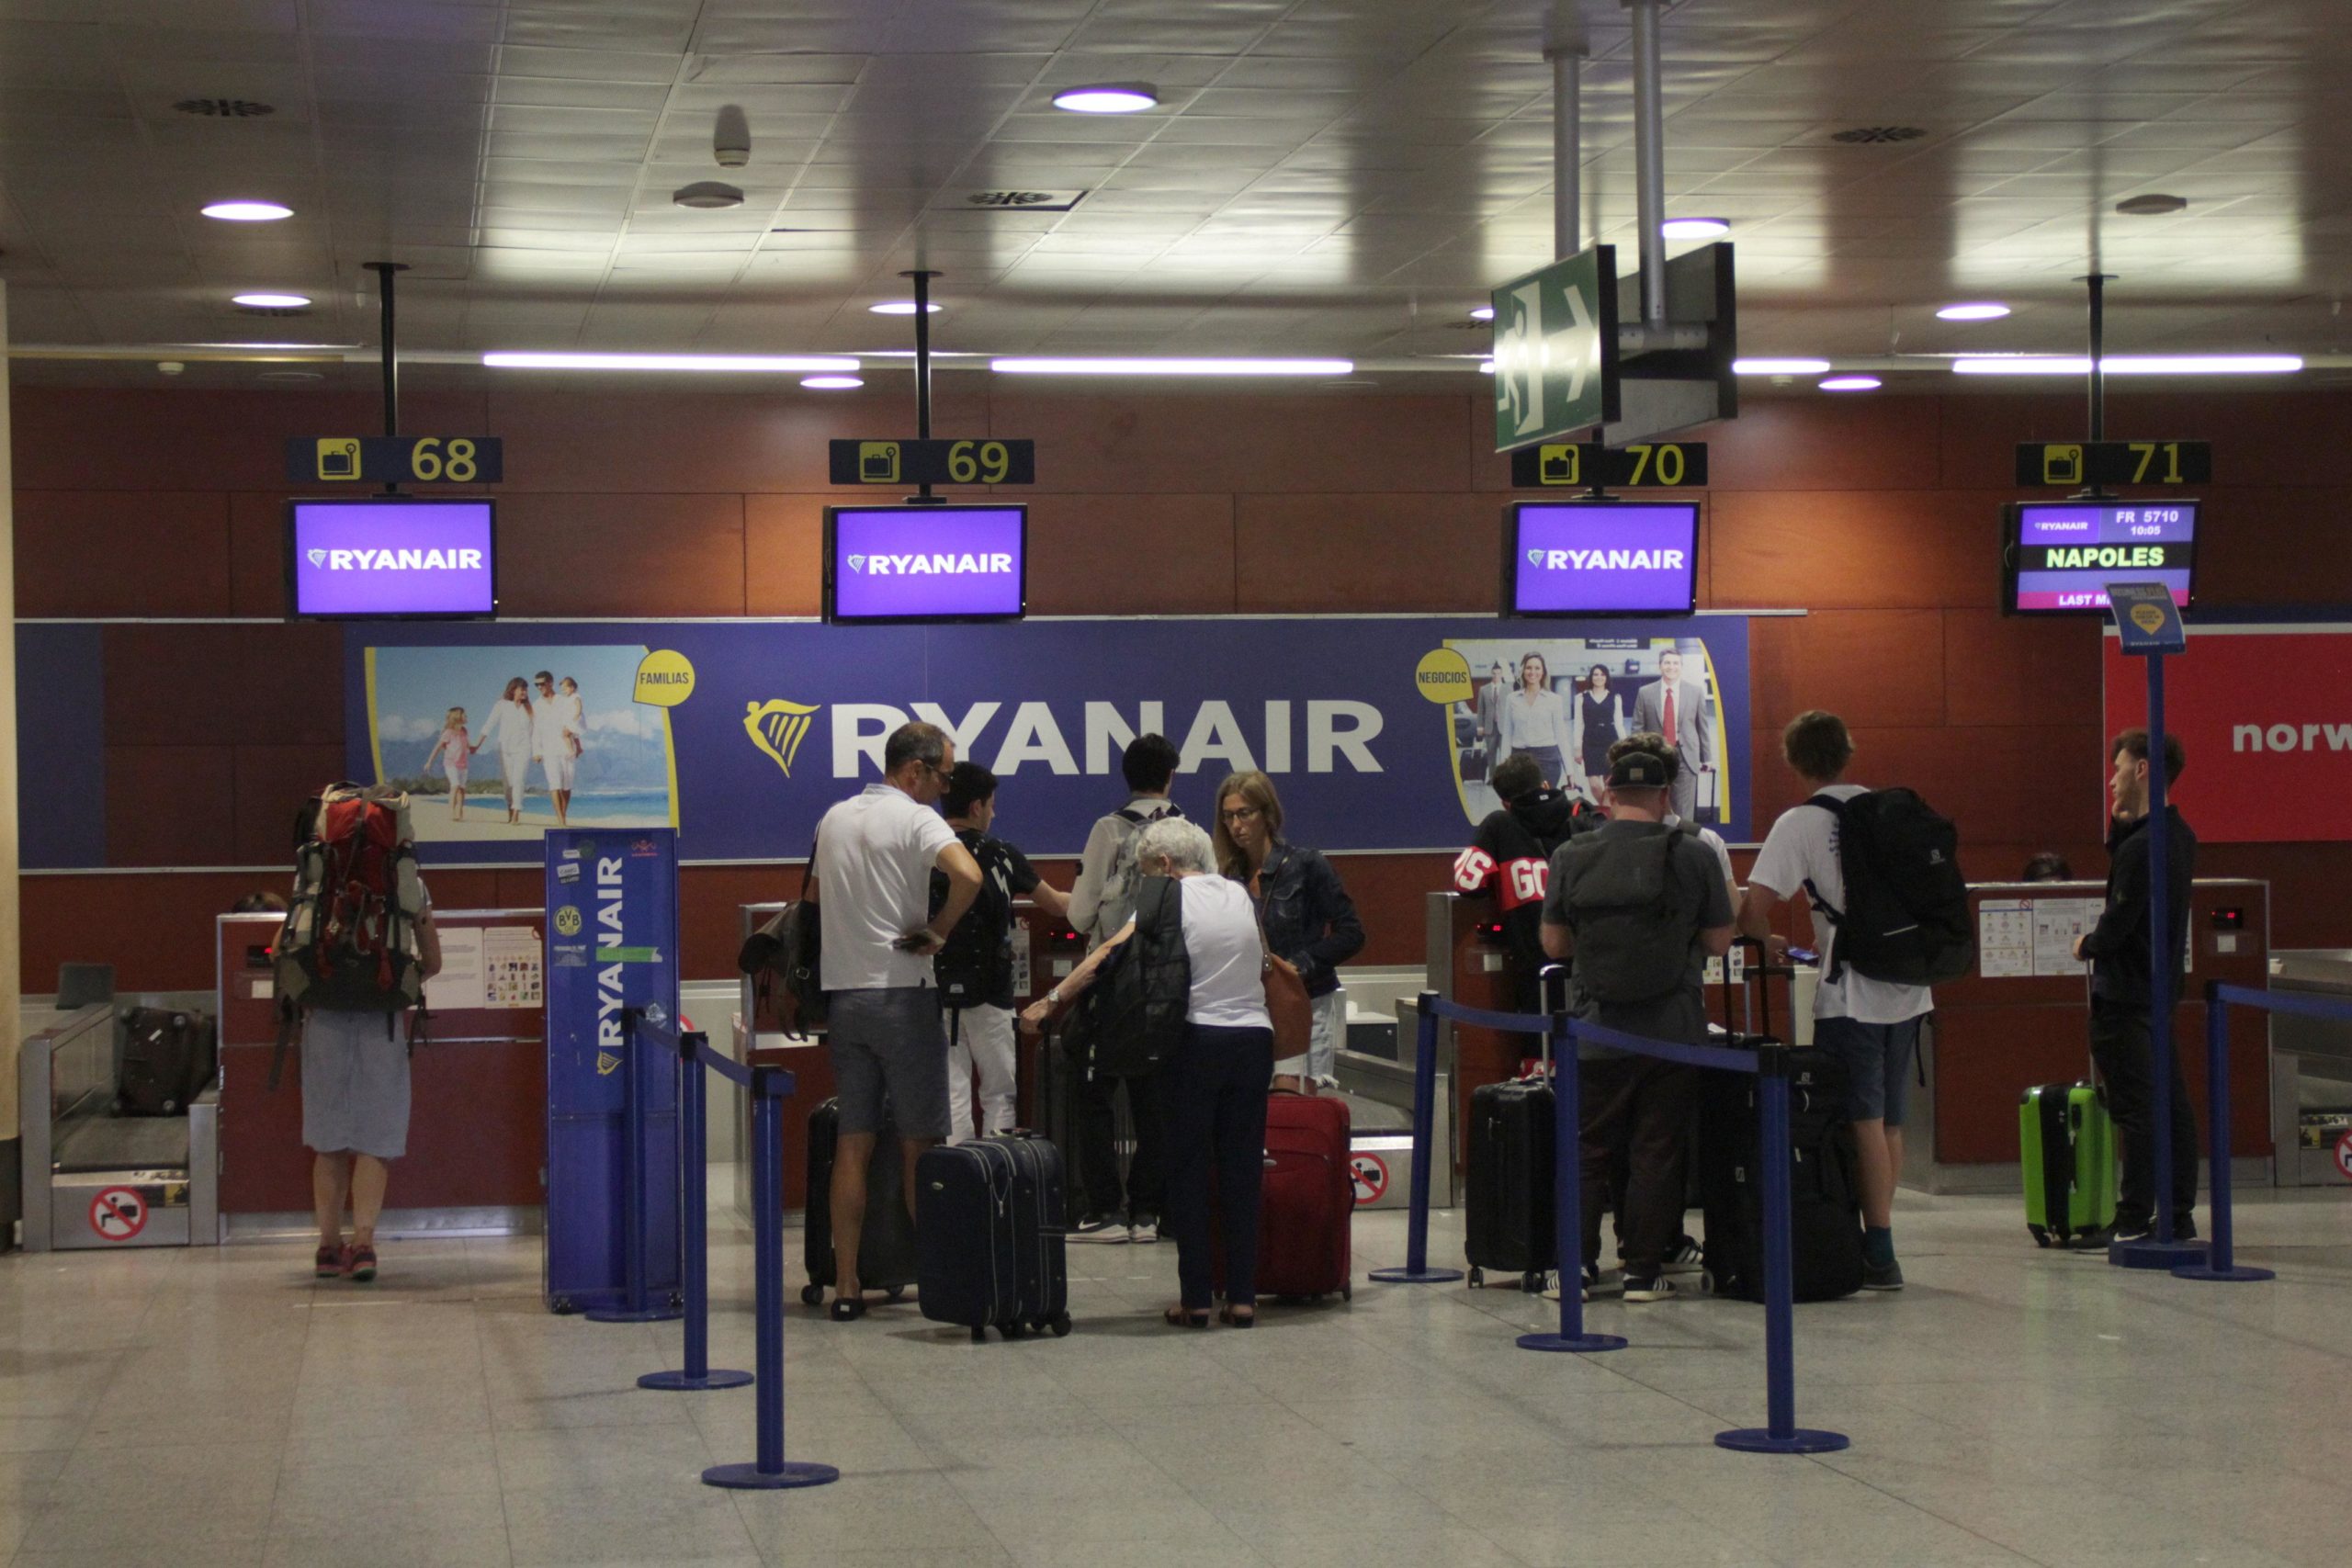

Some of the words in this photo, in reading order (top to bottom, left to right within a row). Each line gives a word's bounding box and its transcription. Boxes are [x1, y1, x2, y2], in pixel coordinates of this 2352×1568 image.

[411, 438, 477, 481] 68
[947, 441, 1009, 483] 69
[1625, 444, 1686, 485] 70
[2129, 443, 2183, 483] 71
[2041, 522, 2088, 531] RYANAIR
[2116, 511, 2135, 523] FR
[2143, 511, 2179, 523] 5710
[2131, 525, 2161, 536] 10:05
[329, 548, 481, 570] RYANAIR
[868, 553, 1012, 575] RYANAIR
[1546, 549, 1683, 570] RYANAIR
[2046, 547, 2165, 568] NAPOLES
[2059, 594, 2093, 606] LAST
[639, 671, 689, 684] FAMILIAS
[1418, 671, 1467, 684] NEGOCIOS
[831, 699, 1385, 778] RYANAIR
[559, 910, 580, 927] BVB
